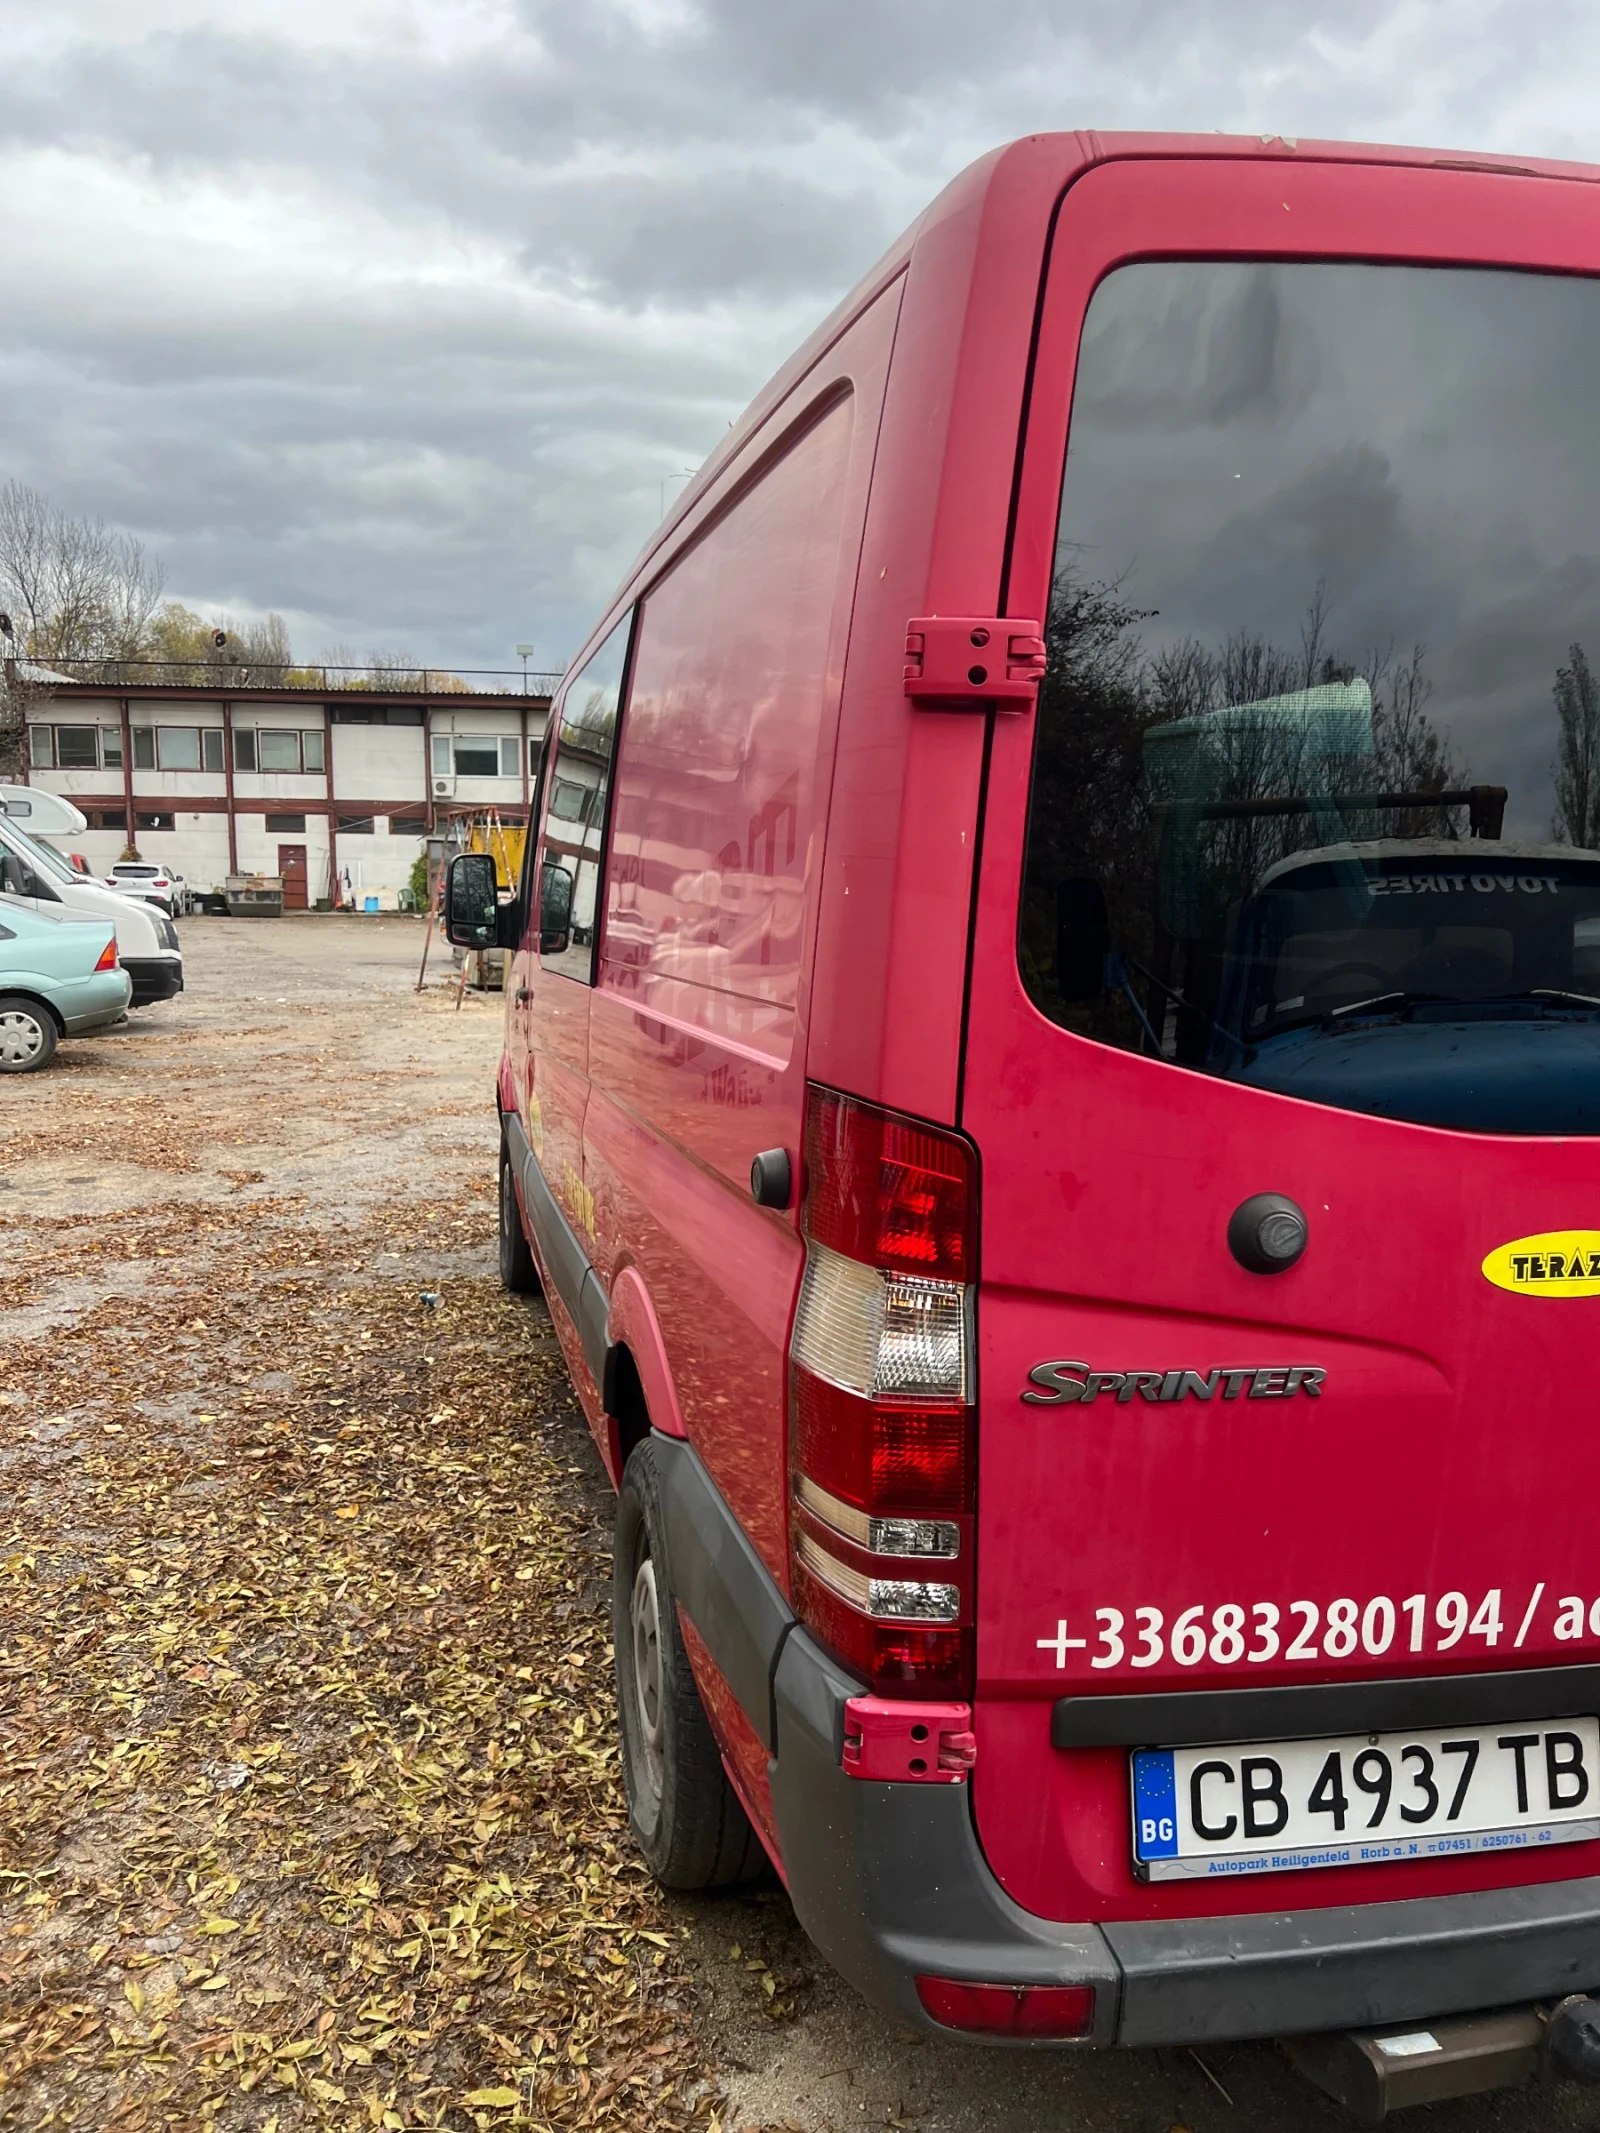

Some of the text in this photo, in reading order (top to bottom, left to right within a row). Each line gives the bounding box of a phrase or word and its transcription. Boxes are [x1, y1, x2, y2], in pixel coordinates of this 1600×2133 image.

[1023, 1361, 1327, 1404] SPRINTER
[1036, 1589, 1504, 1669] +33683280194
[1190, 1731, 1590, 1841] CB 4937 TB
[1141, 1817, 1174, 1844] BG
[1208, 1857, 1268, 1873] Autopark
[1271, 1850, 1350, 1868] Heiligenfeld
[1360, 1846, 1390, 1859] Horb
[1438, 1837, 1472, 1851] 07451
[1481, 1830, 1528, 1848] 6250761
